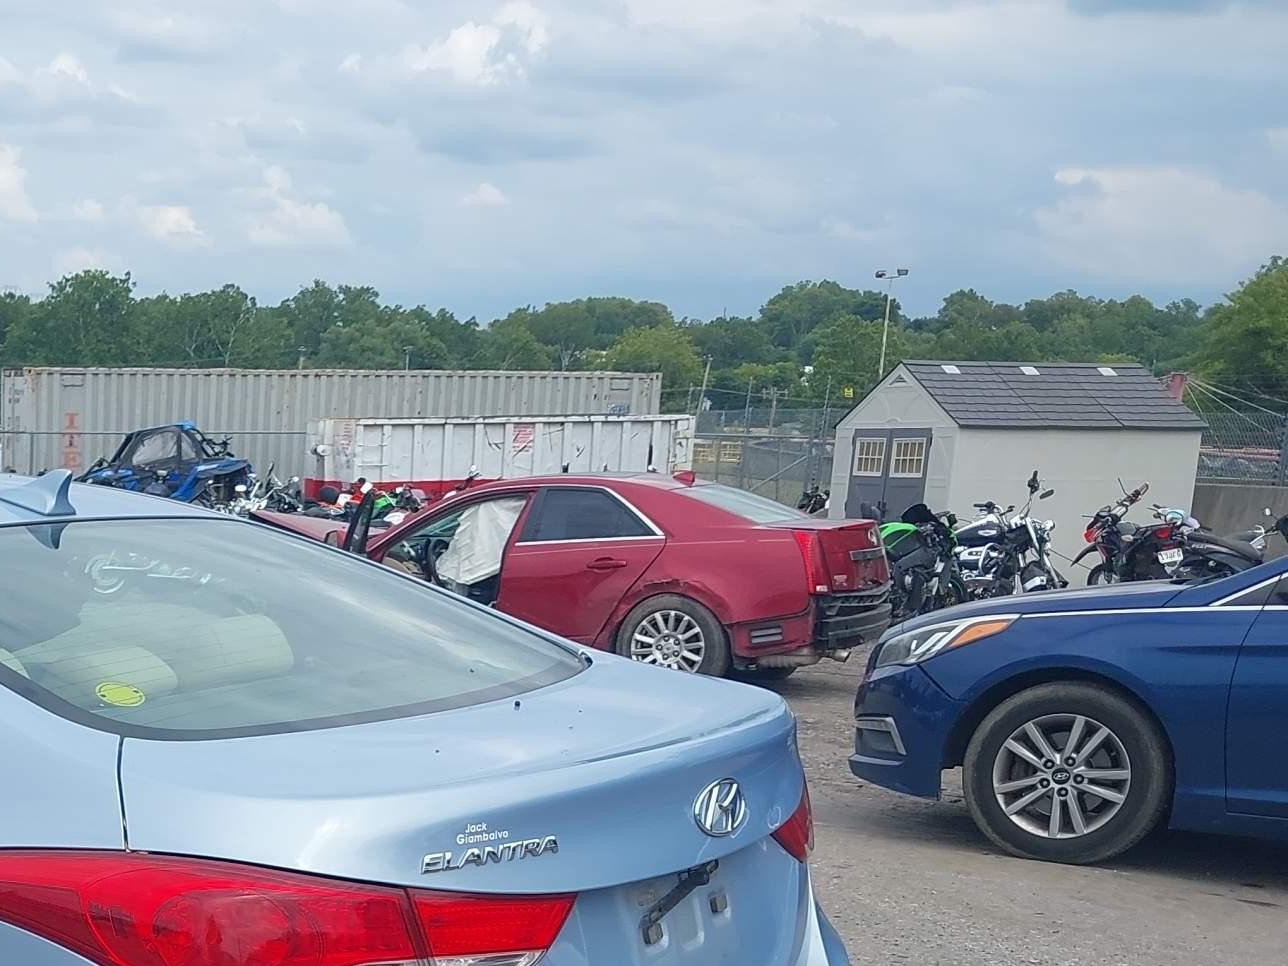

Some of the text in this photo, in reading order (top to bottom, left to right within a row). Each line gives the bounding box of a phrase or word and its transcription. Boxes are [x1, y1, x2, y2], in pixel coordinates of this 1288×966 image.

[465, 821, 488, 834] Jack
[456, 830, 509, 845] Giambalvo
[421, 835, 560, 875] ELANTRA
